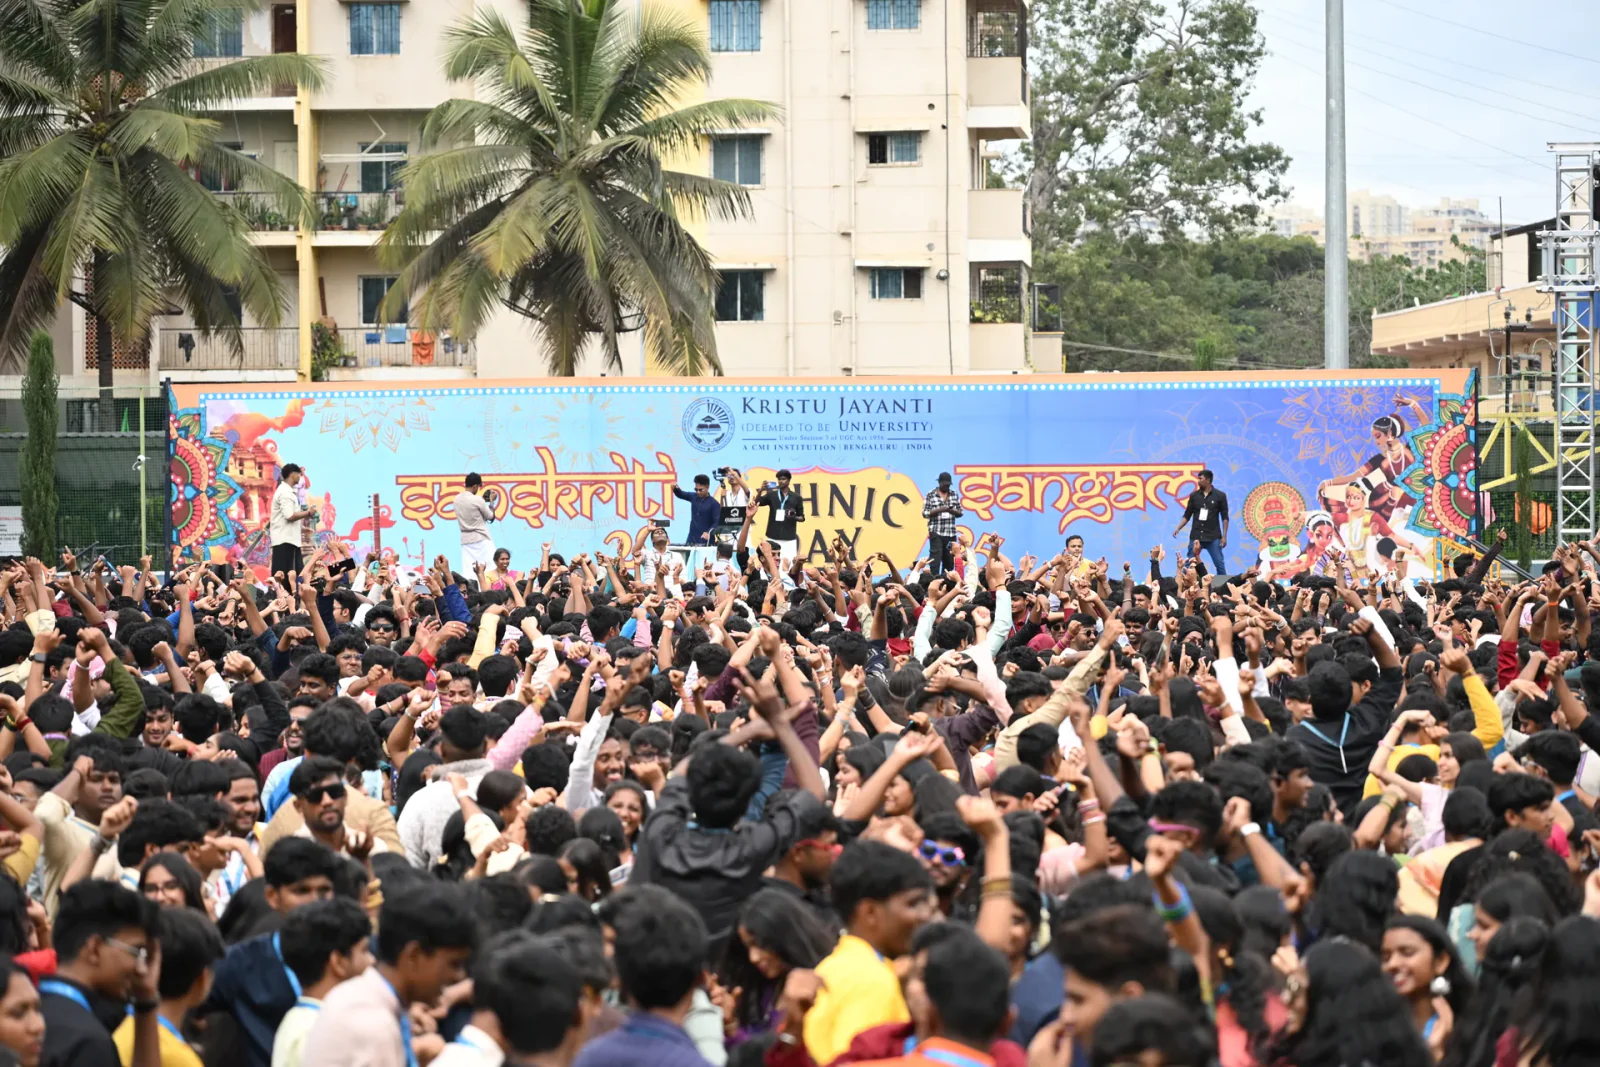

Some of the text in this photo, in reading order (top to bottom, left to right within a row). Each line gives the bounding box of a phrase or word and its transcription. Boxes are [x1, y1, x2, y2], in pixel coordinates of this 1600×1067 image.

[742, 396, 933, 418] KRISTU JAYANTI
[741, 420, 934, 432] (DEEMED TO BE UNIVERSITY)
[742, 443, 932, 451] A CMI INSTITUTION BENGALURU INDIA
